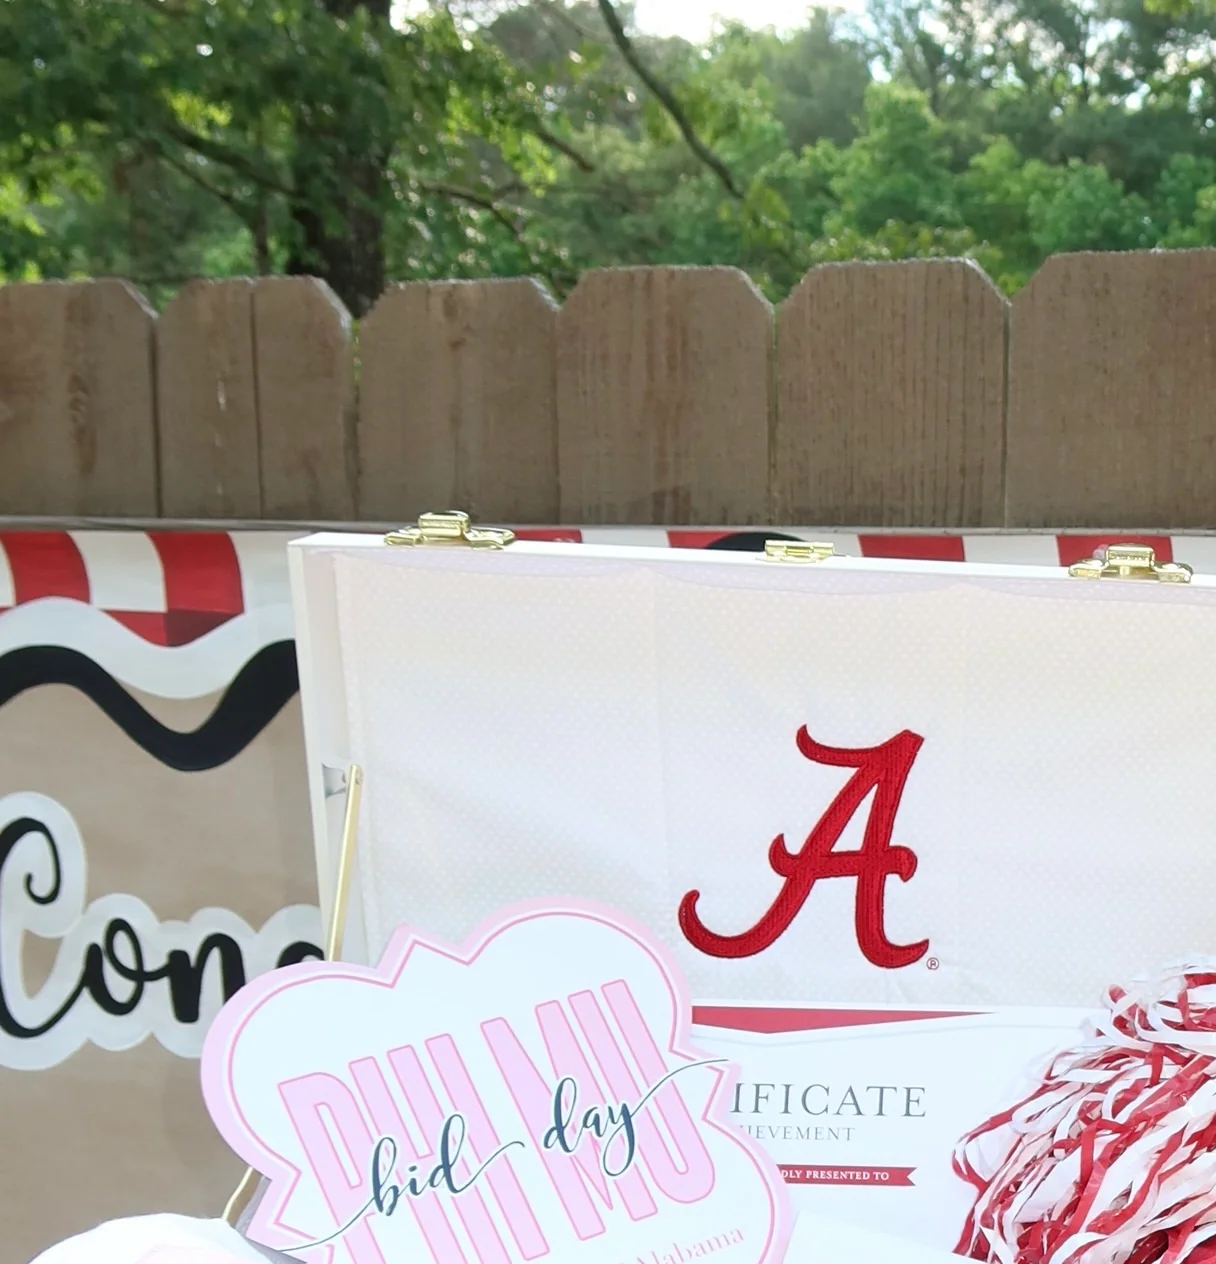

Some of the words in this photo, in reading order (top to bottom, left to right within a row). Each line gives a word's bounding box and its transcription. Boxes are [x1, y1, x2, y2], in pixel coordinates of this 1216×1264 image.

[0, 817, 325, 1039] Con
[678, 724, 930, 970] A
[479, 979, 716, 1241] MU
[543, 1058, 729, 1177] day
[739, 1124, 856, 1141] IEVEMENT
[805, 1170, 871, 1181] PRESENTED
[873, 1171, 890, 1181] TO
